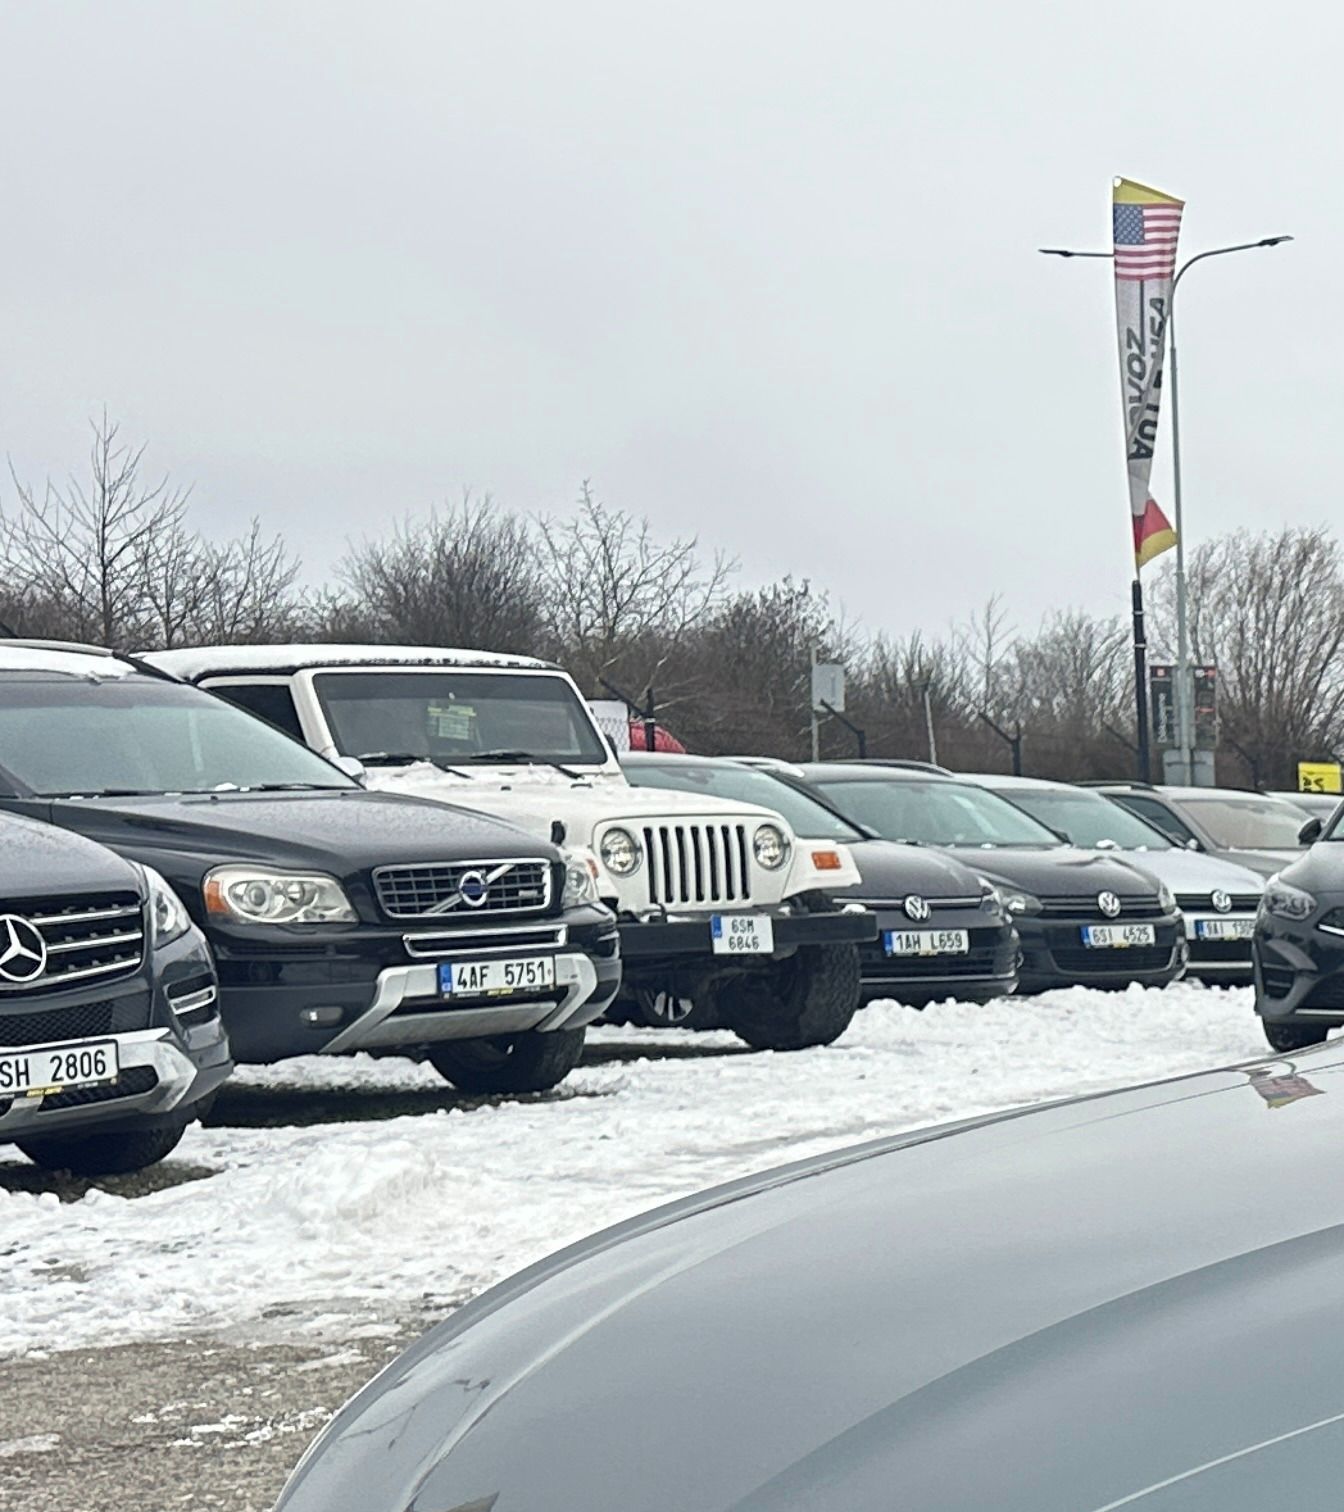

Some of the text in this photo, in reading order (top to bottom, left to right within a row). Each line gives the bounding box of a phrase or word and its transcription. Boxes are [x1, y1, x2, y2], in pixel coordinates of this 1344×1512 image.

[457, 961, 546, 989] 4AF 5751
[49, 1049, 107, 1082] 2806
